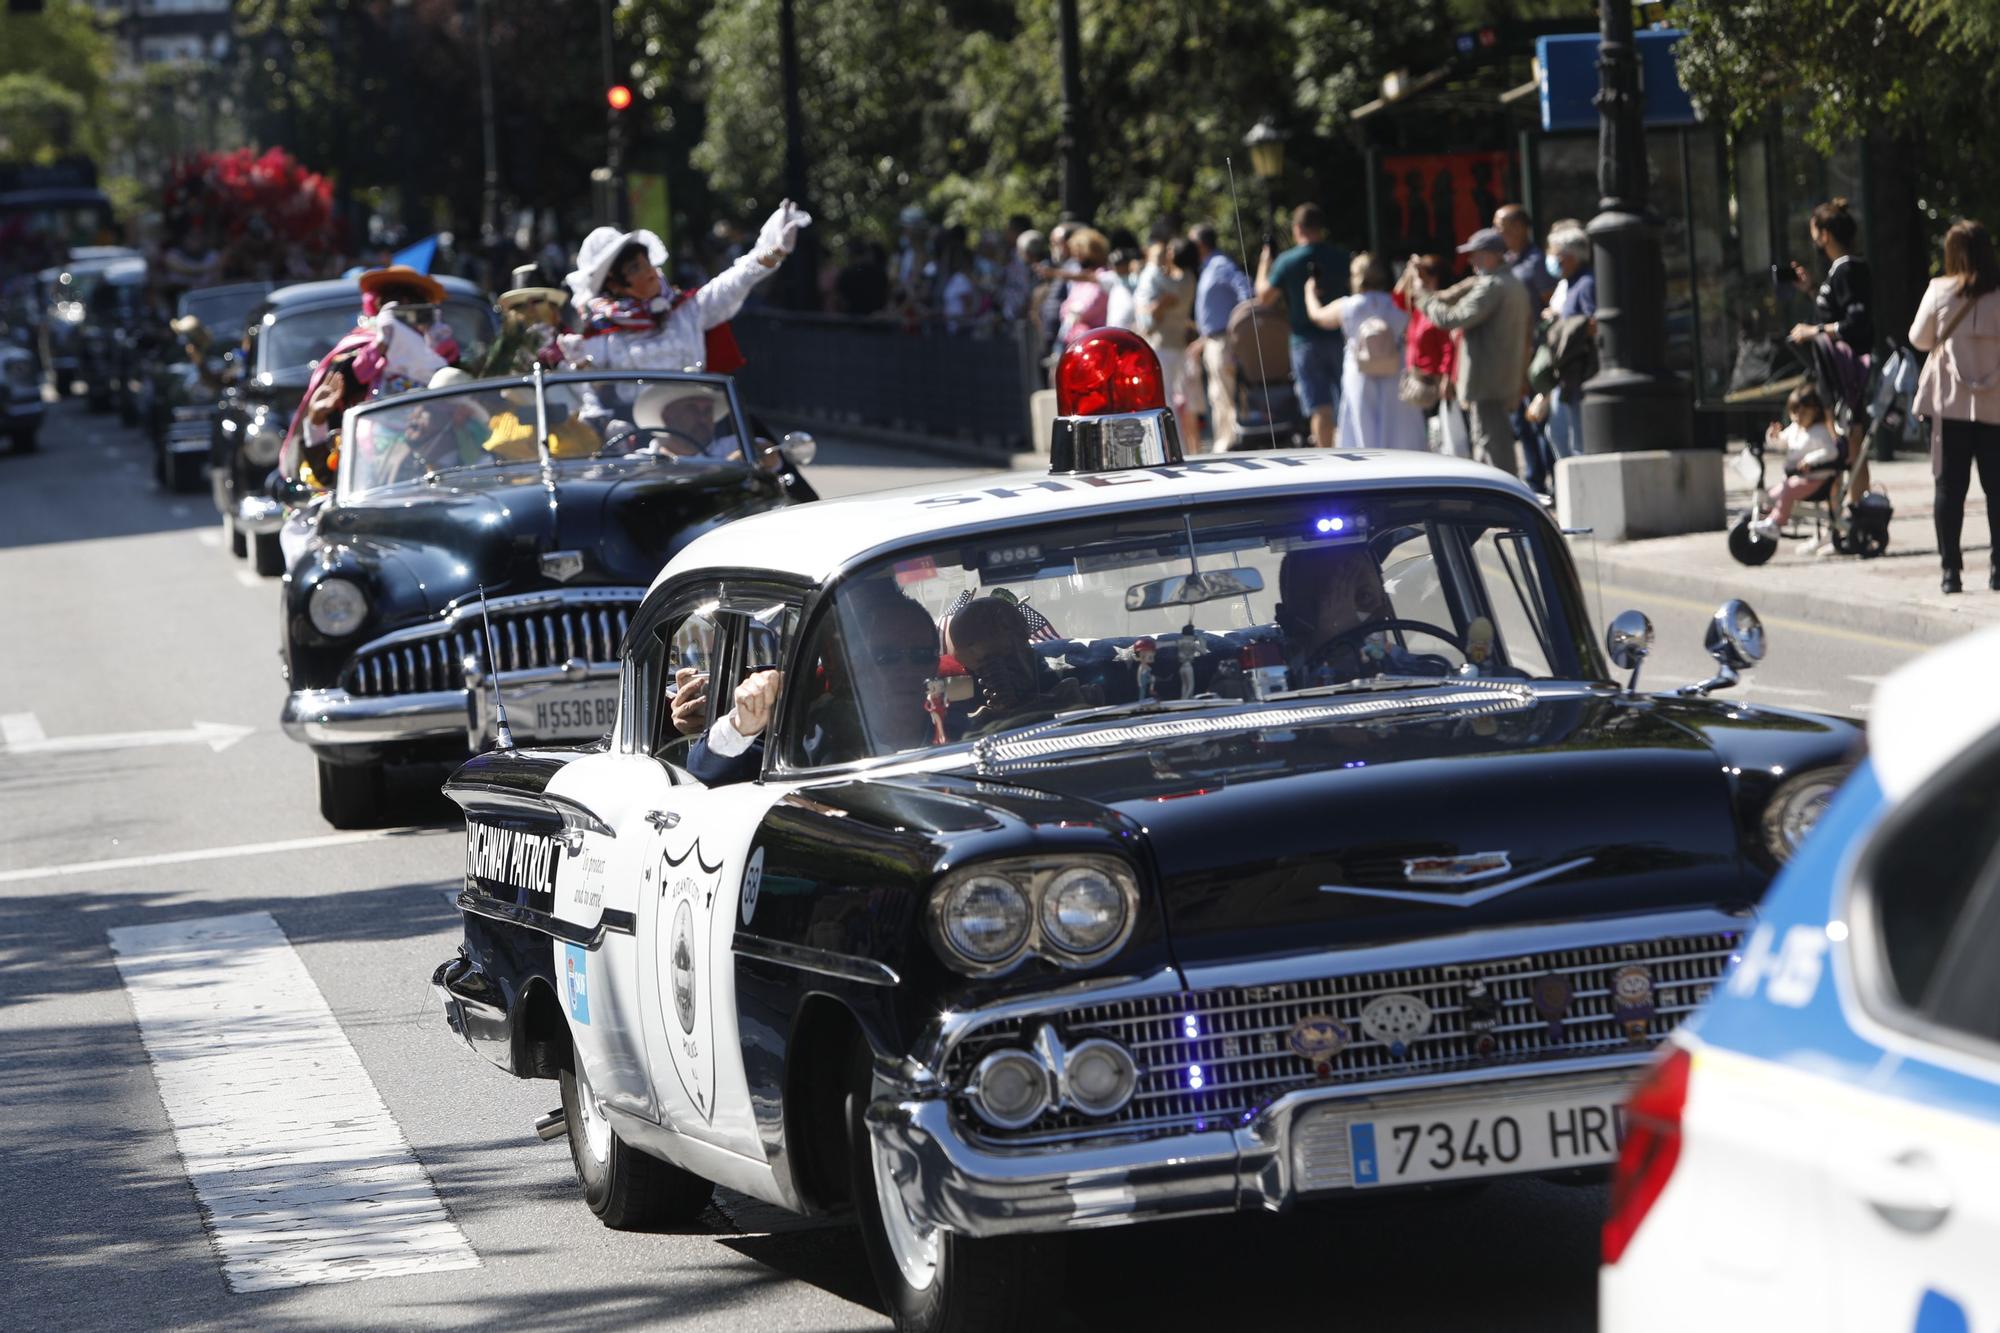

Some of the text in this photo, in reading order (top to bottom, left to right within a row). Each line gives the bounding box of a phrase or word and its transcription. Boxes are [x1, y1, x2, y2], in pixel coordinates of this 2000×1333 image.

[914, 450, 1387, 510] SHERIFF
[595, 697, 619, 725] BB
[467, 822, 553, 893] HIGHWAY PATROL
[1392, 1115, 1522, 1176] 7340
